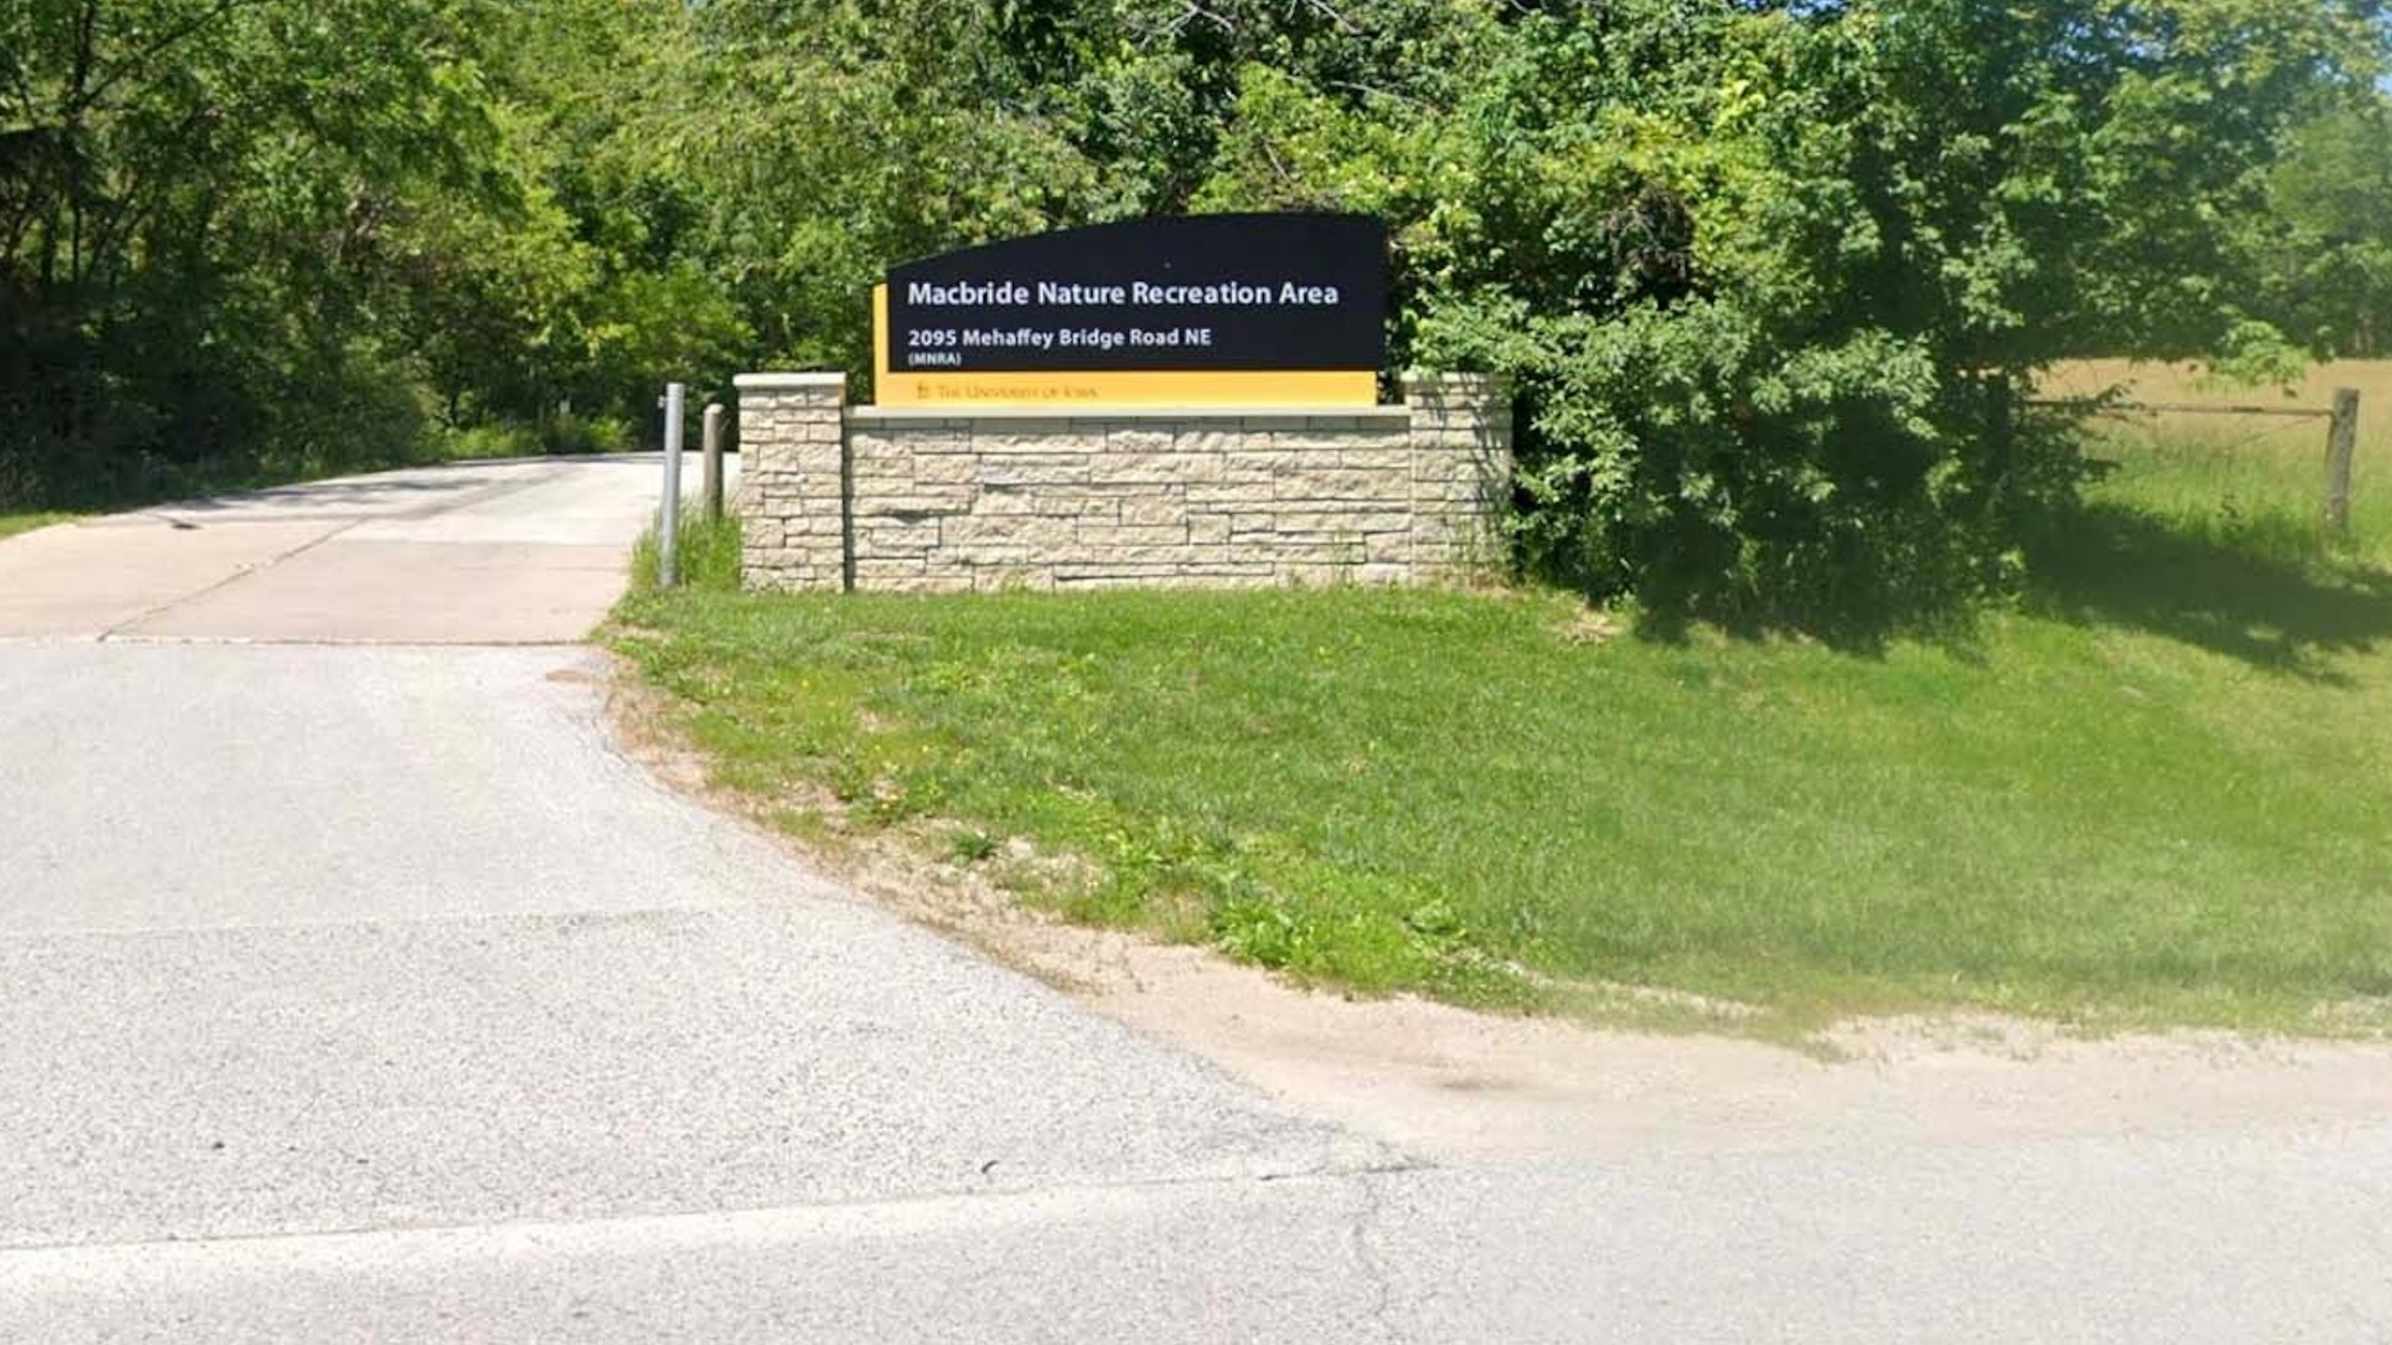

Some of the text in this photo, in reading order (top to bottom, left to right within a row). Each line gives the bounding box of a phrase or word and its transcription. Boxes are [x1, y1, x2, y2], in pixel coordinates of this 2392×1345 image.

[908, 281, 1338, 304] Macbride Nature Recreation Area
[908, 328, 1212, 350] 2095 Mehaffey Bridge Road NE
[908, 352, 962, 367] (MNRA)
